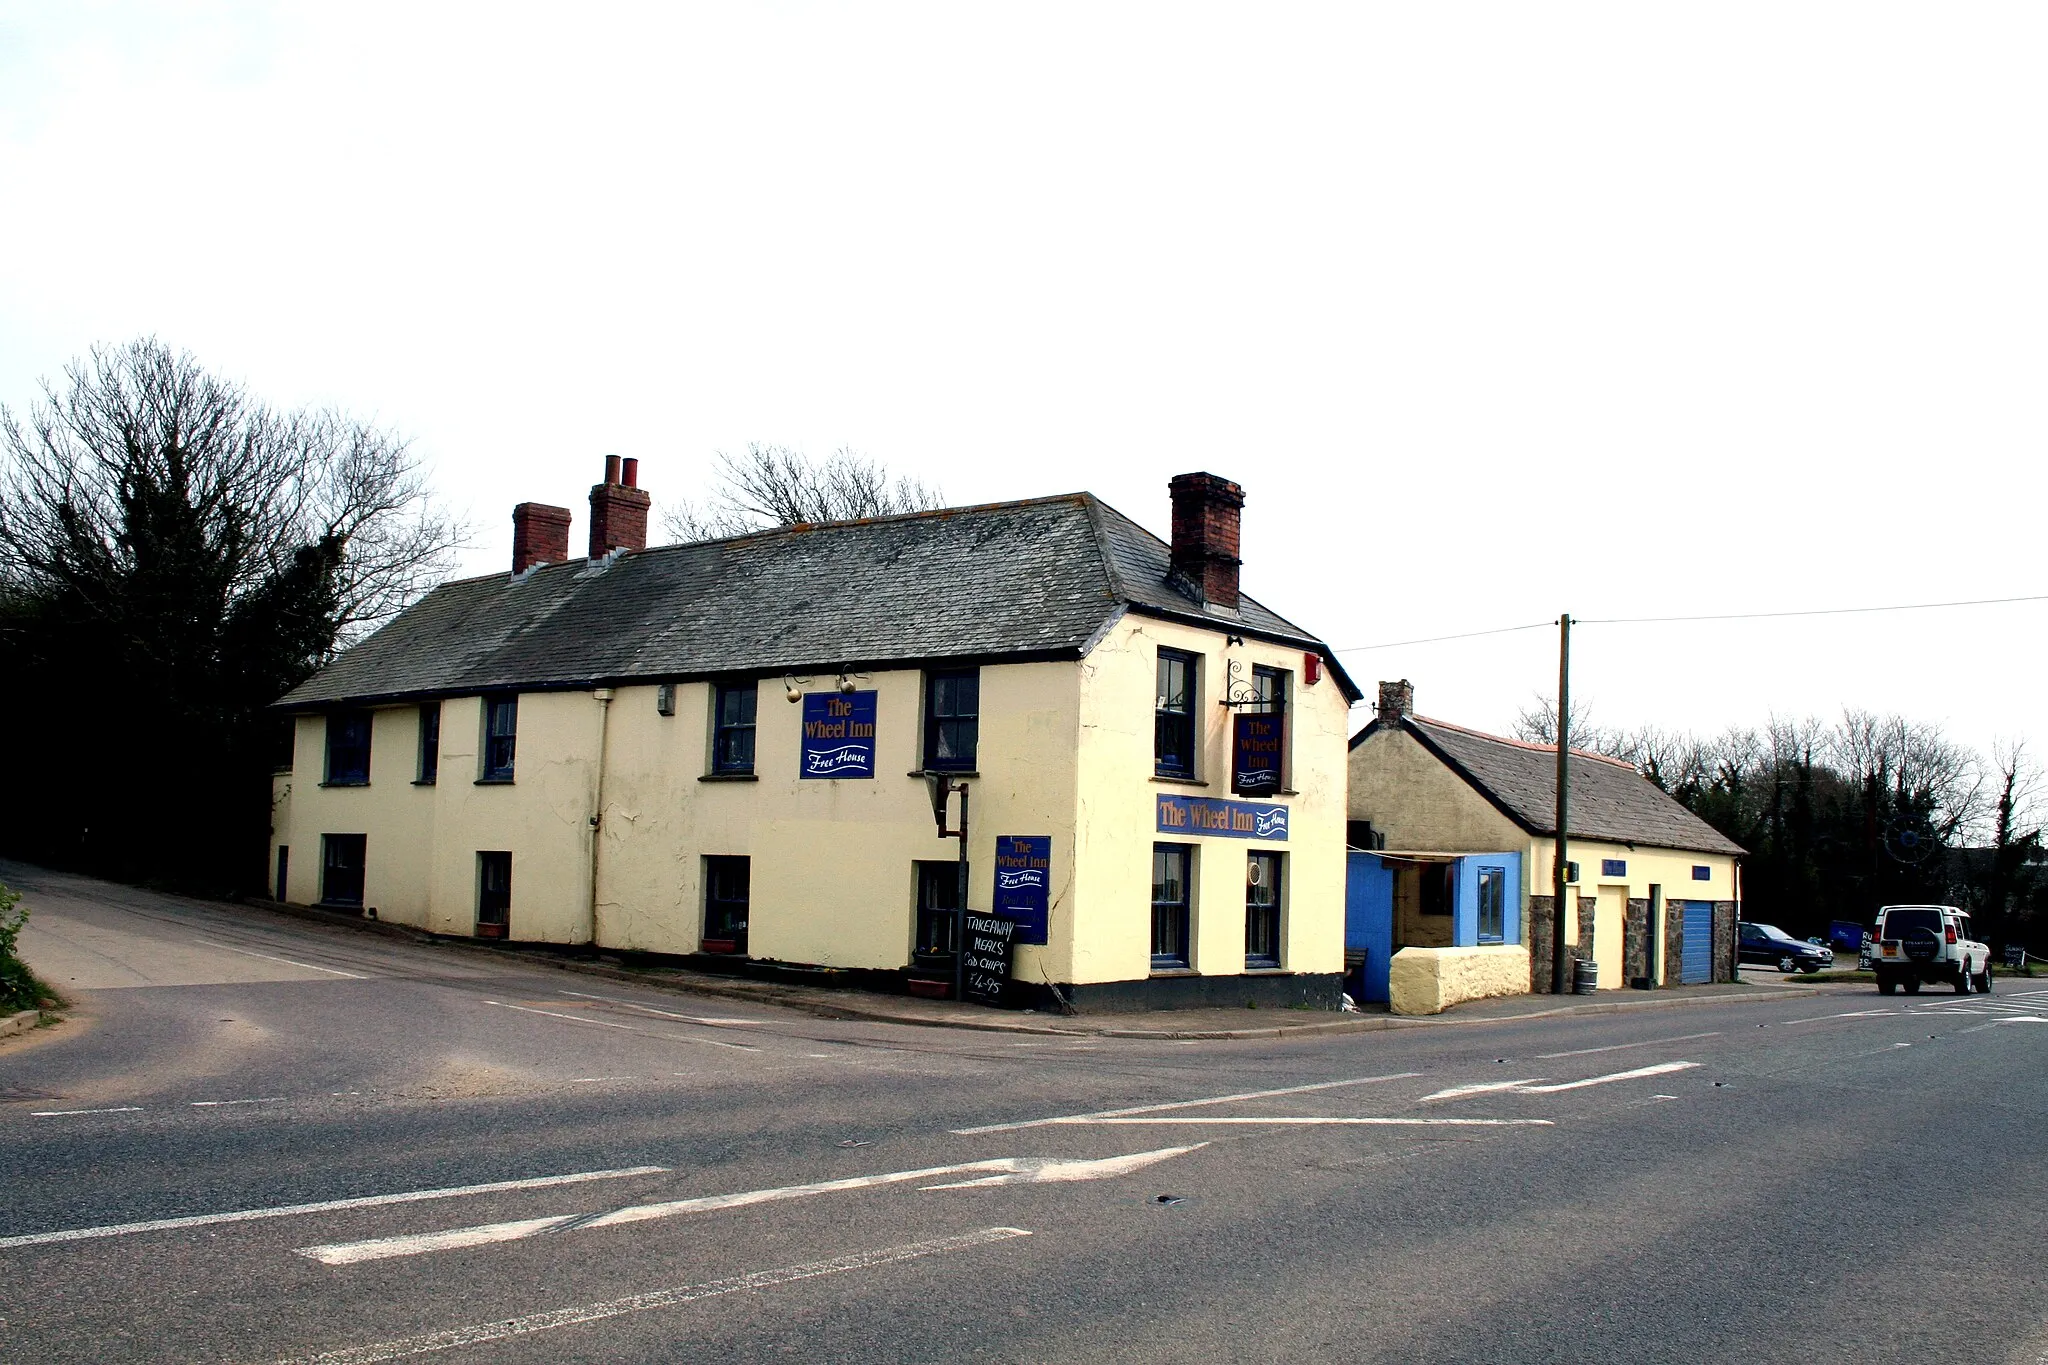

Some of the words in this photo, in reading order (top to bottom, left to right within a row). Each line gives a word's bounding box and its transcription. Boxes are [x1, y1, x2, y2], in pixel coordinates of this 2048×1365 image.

[828, 698, 852, 717] The
[805, 720, 846, 739] Wheel
[849, 720, 874, 738] Inn
[1248, 720, 1271, 735] The
[1241, 737, 1278, 752] Wheel
[808, 754, 834, 770] Free
[835, 749, 866, 764] House
[1248, 755, 1269, 768] Inn
[1238, 774, 1255, 785] Free
[1160, 800, 1186, 827] The
[1189, 804, 1230, 830] Wheel
[1232, 808, 1254, 832] Inn
[1256, 817, 1271, 832] Free
[1271, 812, 1286, 827] House
[1013, 840, 1032, 854] The
[997, 855, 1027, 868] Wheel
[1030, 856, 1048, 868] Inn
[1000, 874, 1018, 886] Free
[1019, 872, 1041, 883] House
[966, 916, 1015, 942] TAKEAWAY
[974, 937, 1004, 956] MEALS
[979, 958, 1006, 975] CHIPS
